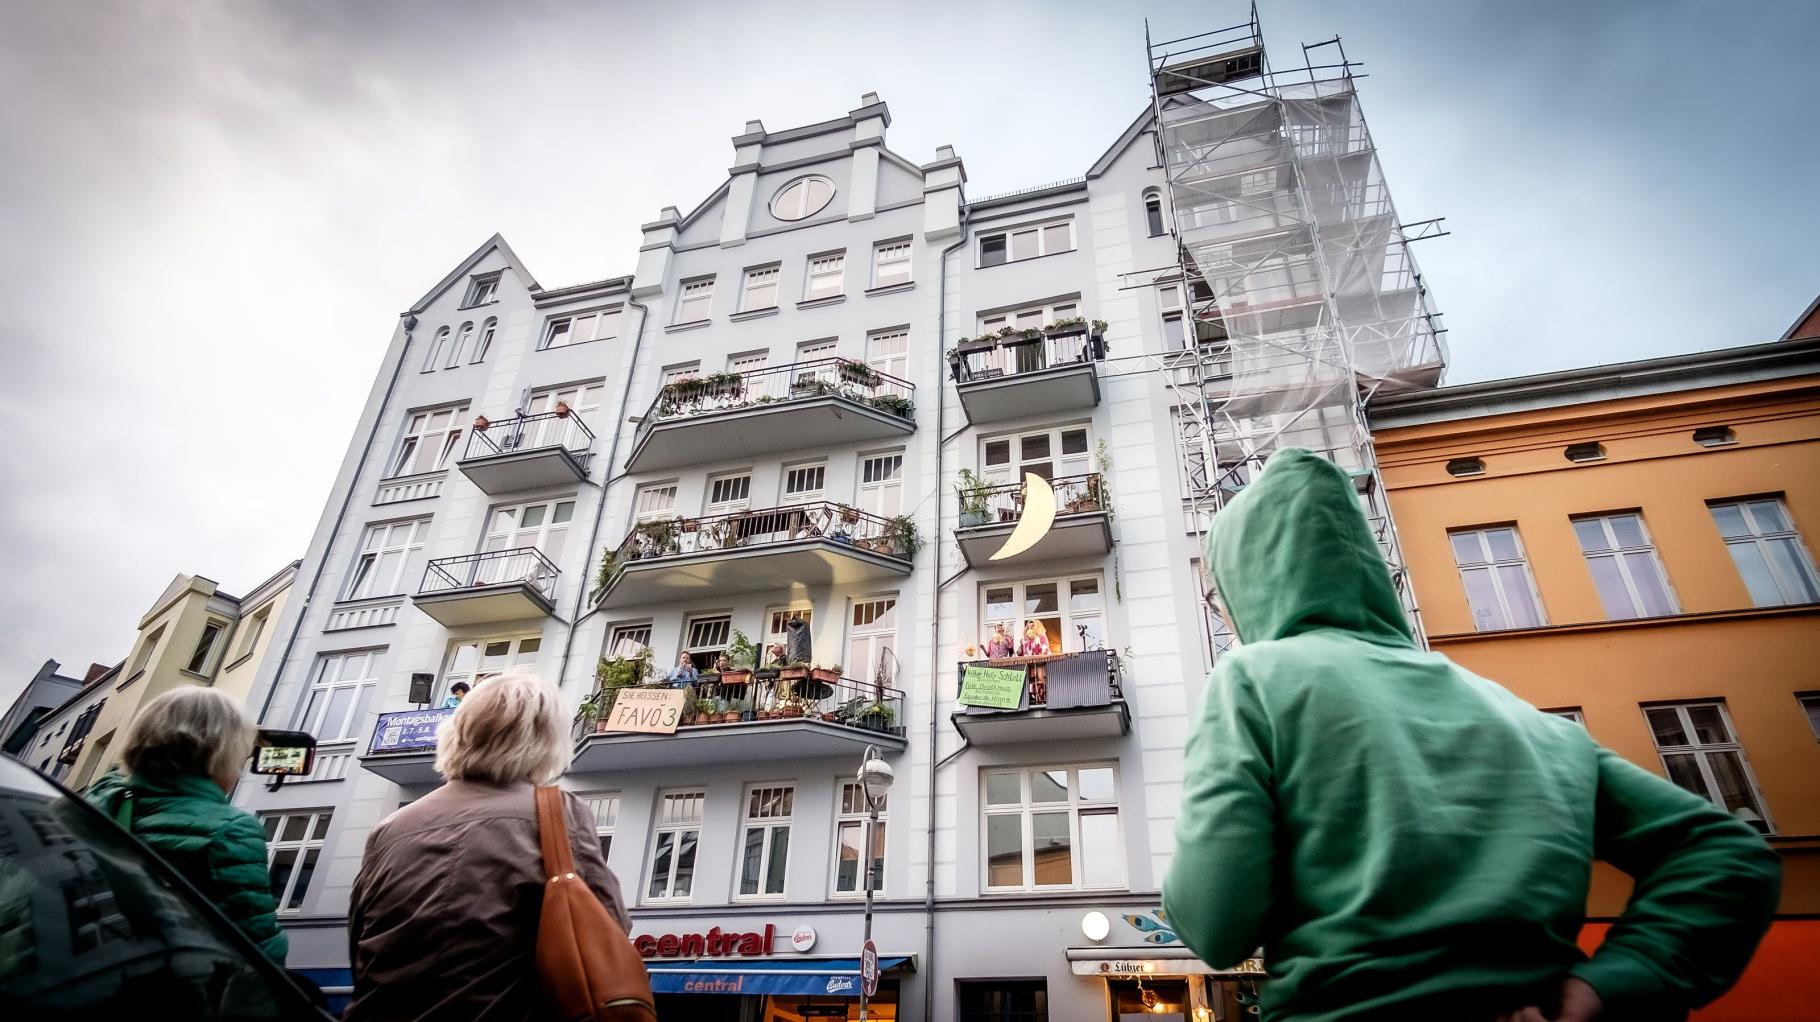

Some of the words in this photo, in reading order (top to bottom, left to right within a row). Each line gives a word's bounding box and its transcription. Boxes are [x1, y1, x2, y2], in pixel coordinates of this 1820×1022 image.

[622, 691, 635, 700] SIE
[662, 708, 677, 727] 3
[633, 923, 776, 956] central
[1114, 961, 1145, 974] Lübzer
[684, 975, 744, 993] central
